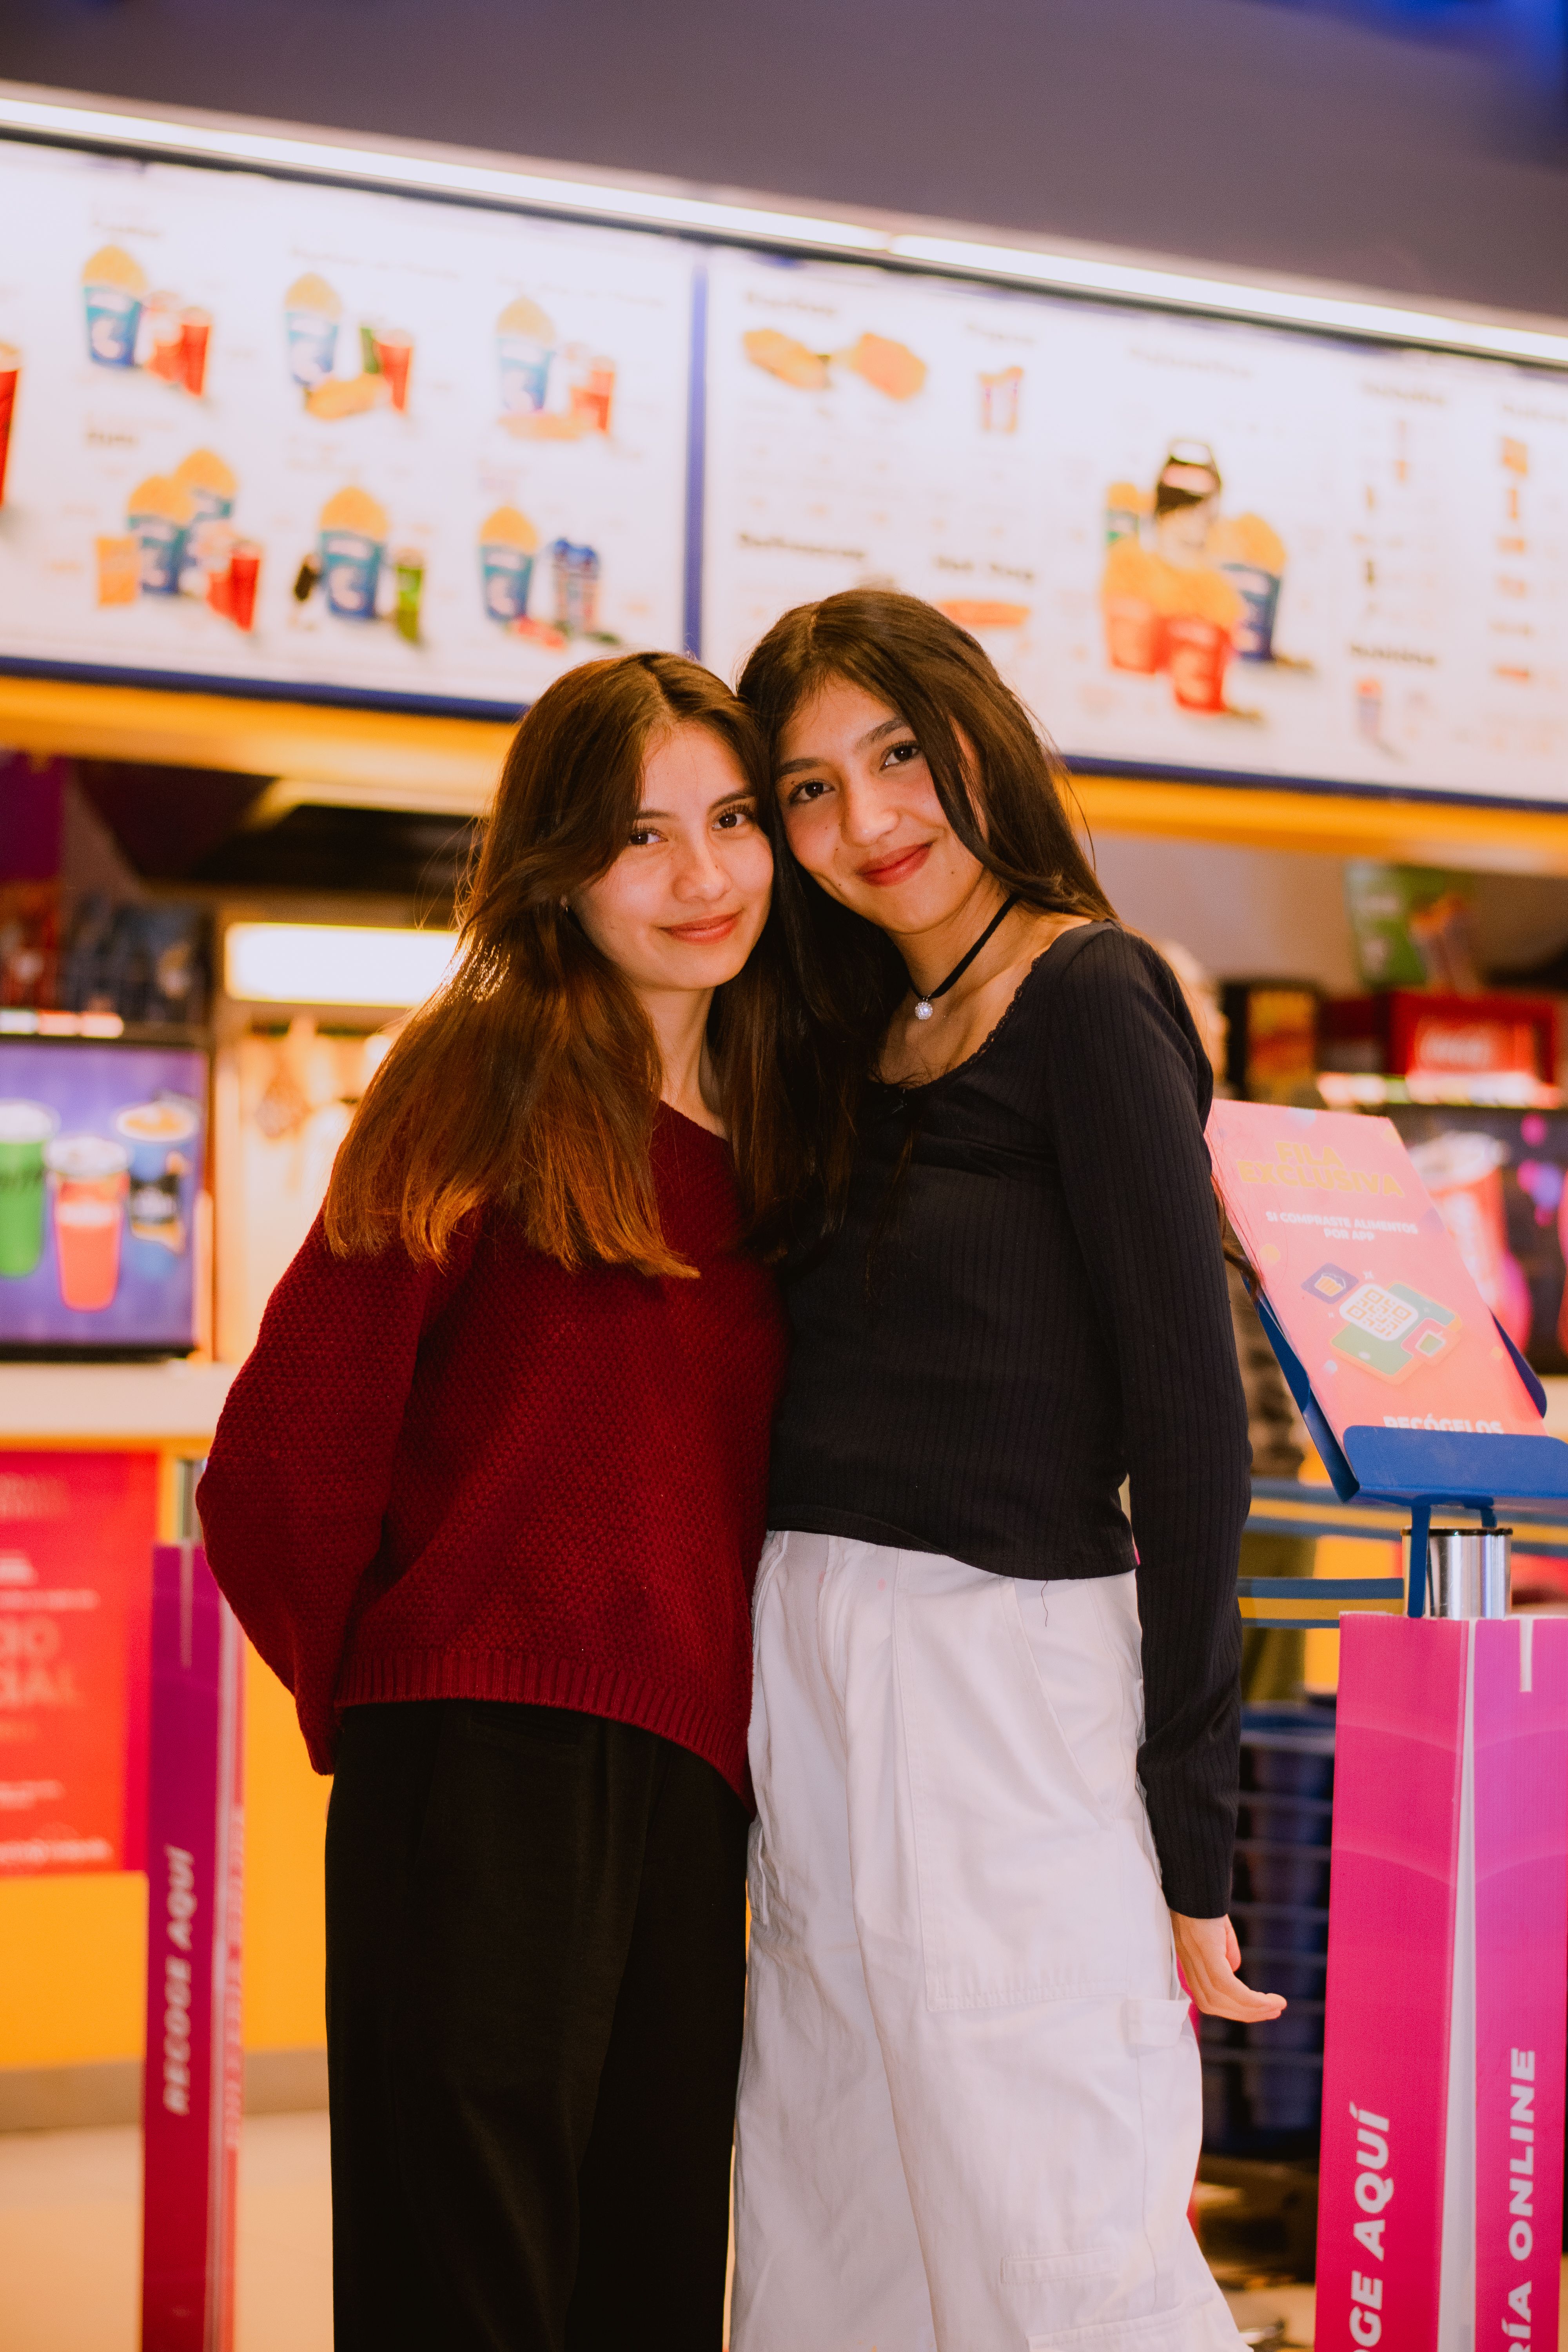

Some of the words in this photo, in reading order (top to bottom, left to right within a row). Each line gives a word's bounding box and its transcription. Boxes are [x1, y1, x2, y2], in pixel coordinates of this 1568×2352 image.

[1236, 1160, 1405, 1197] EXCLUSIVA
[1275, 1141, 1345, 1169] FILA
[1265, 1211, 1278, 1222] SI
[1280, 1212, 1351, 1228] COMPRASTE
[1354, 1218, 1419, 1234] ALIMENTOS
[1323, 1227, 1349, 1240] POR
[1352, 1230, 1375, 1241] APP
[162, 1954, 192, 2116] RECOGE
[1349, 2101, 1394, 2262] AQUÍ
[1508, 2047, 1535, 2261] ONLINE
[1349, 2270, 1383, 2352] GE
